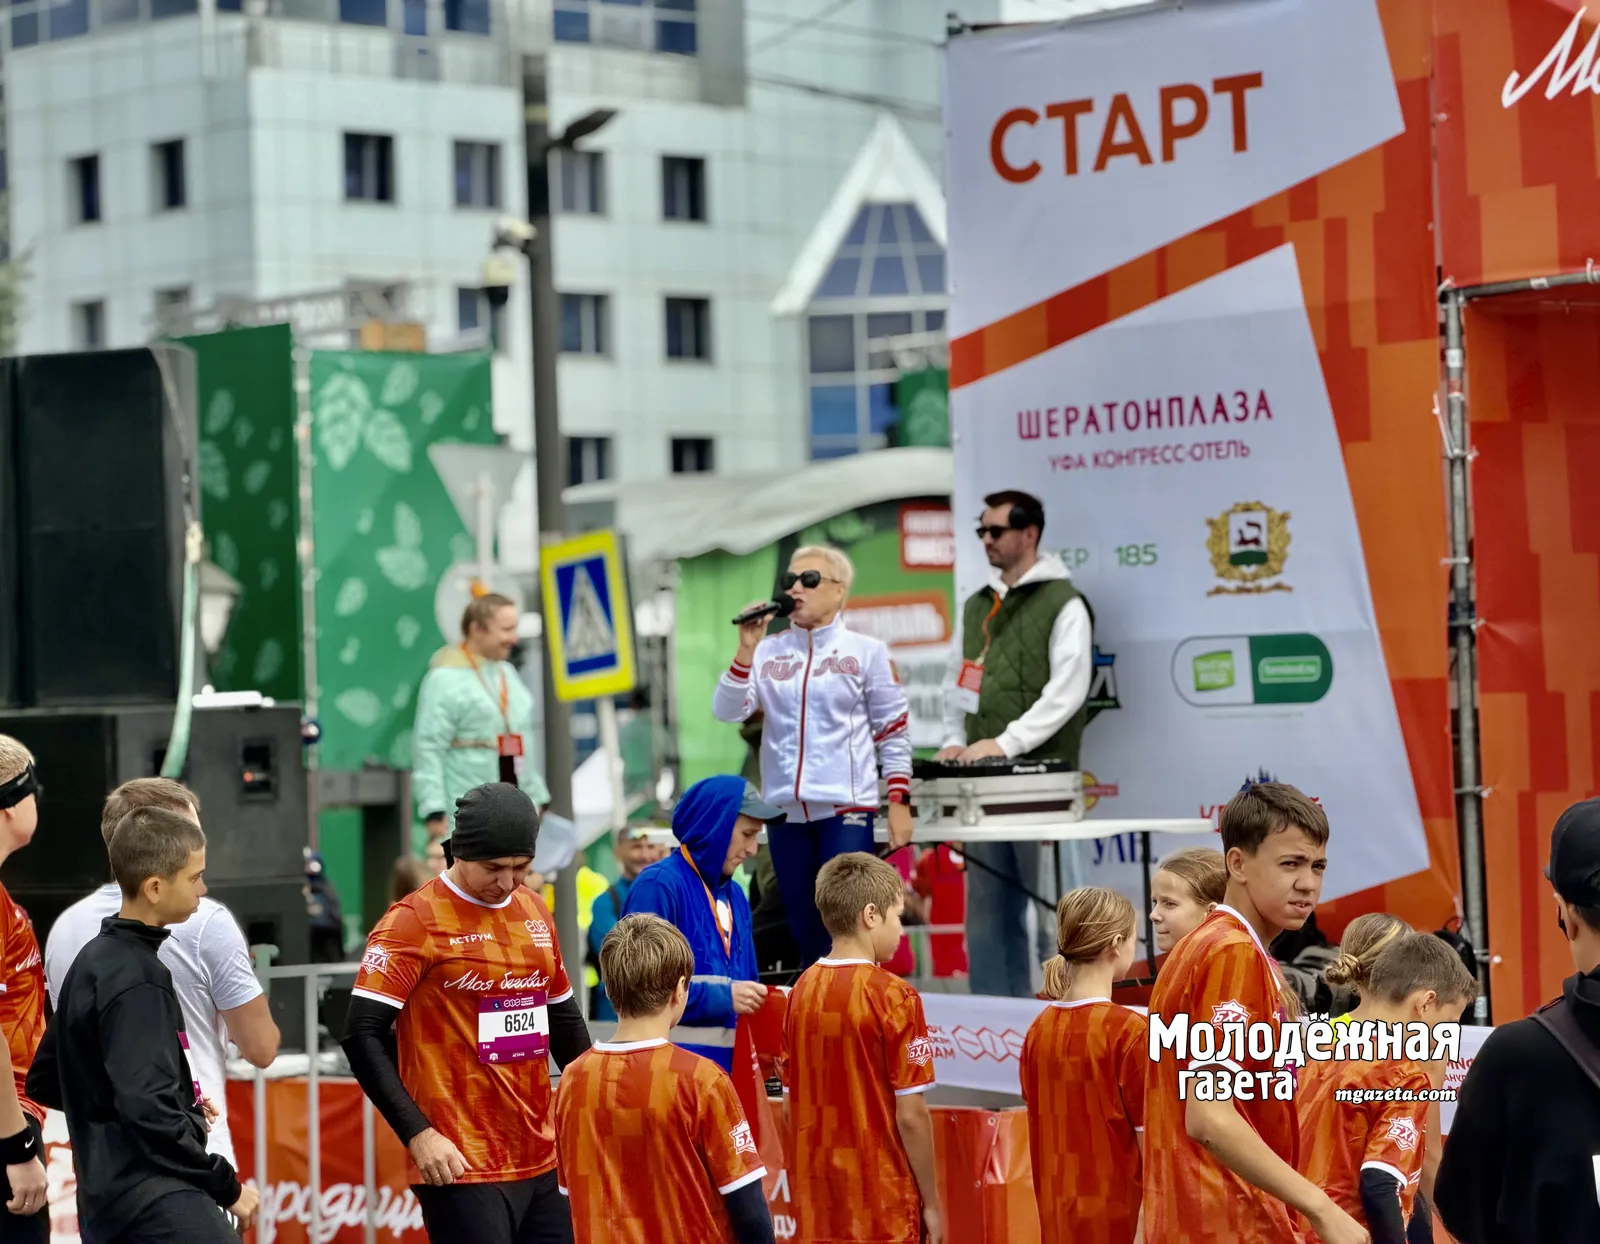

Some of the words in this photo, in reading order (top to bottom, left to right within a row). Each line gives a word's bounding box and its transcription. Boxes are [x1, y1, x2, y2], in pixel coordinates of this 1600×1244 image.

[989, 71, 1263, 184] СТАРТ
[1017, 389, 1273, 440] ШЕРАТОНПЛАЗА
[1049, 454, 1087, 473] УФА
[1093, 440, 1251, 469] КОНГРЕСС-ОТЕЛЬ
[1114, 543, 1158, 566] 185
[449, 933, 494, 946] АСТРУМ
[444, 969, 494, 991] Моя
[500, 969, 550, 990] беговая
[504, 1011, 535, 1033] 6524
